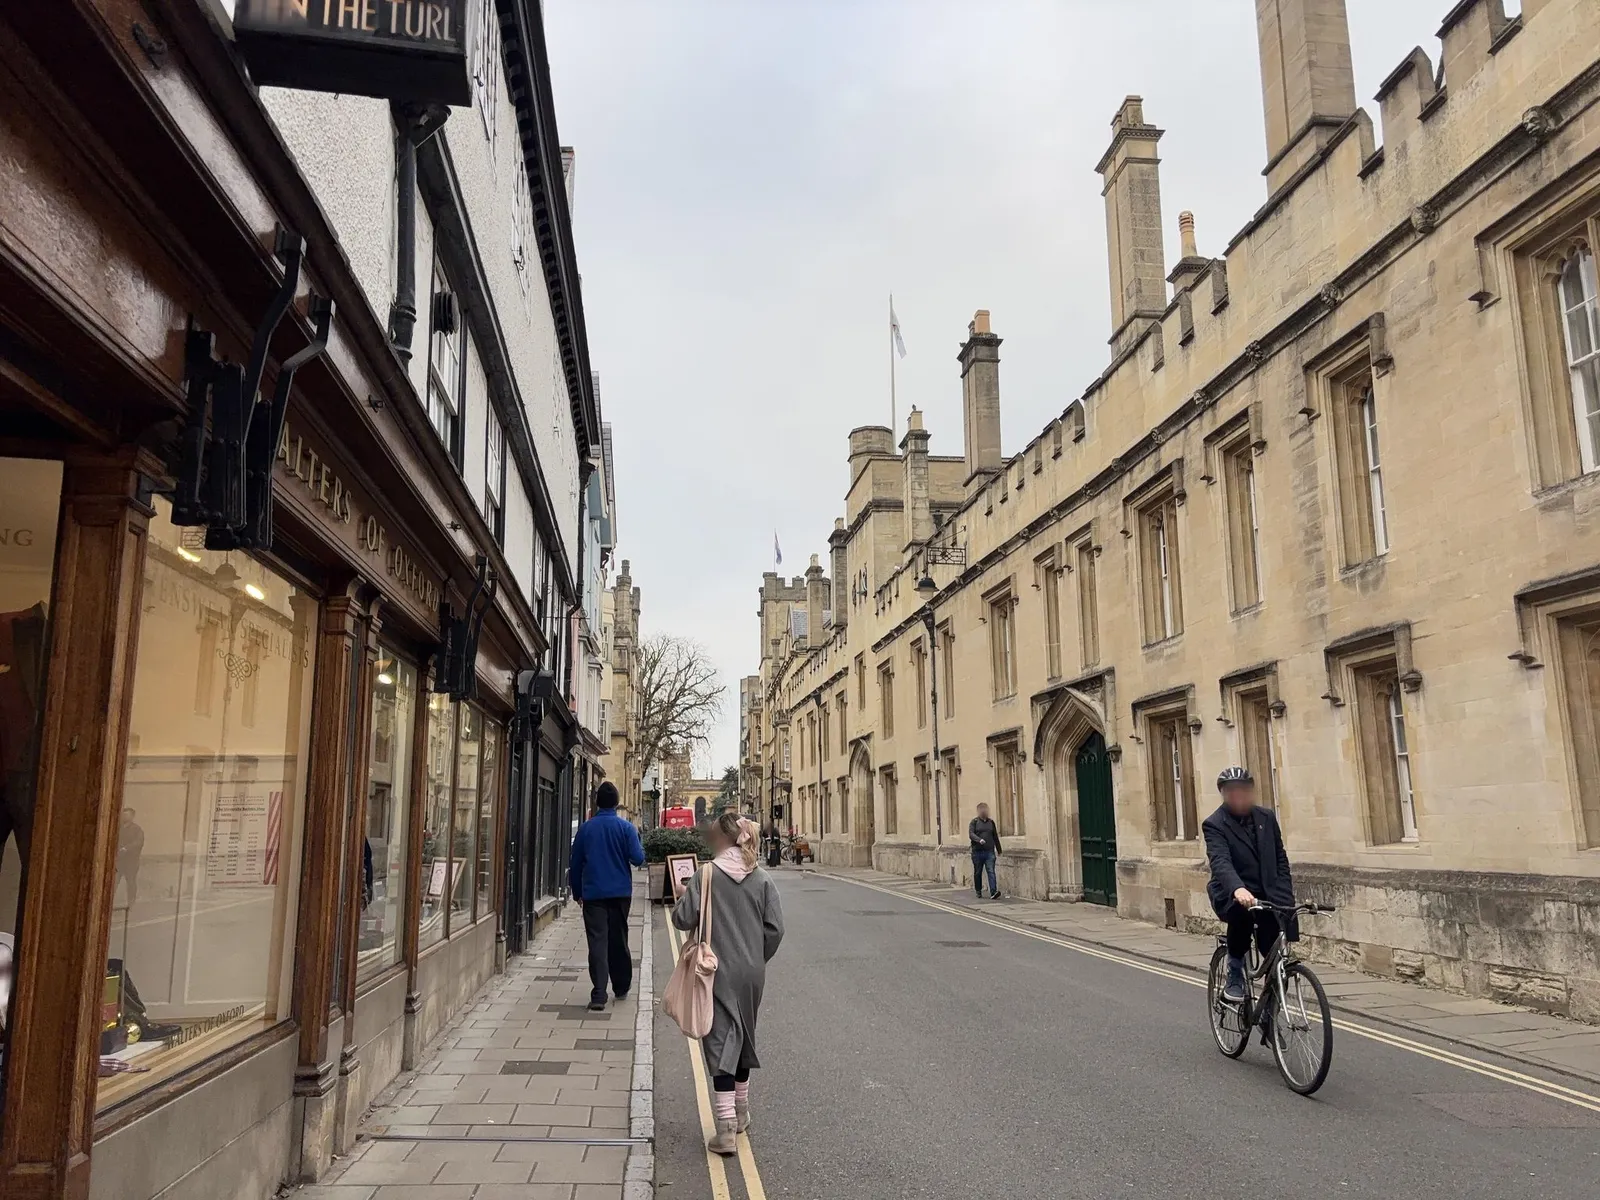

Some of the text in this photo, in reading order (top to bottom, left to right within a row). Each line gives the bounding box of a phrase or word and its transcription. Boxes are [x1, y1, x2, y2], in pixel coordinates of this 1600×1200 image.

[388, 0, 456, 42] TURL
[277, 421, 440, 613] ALTERS OF OXFORD
